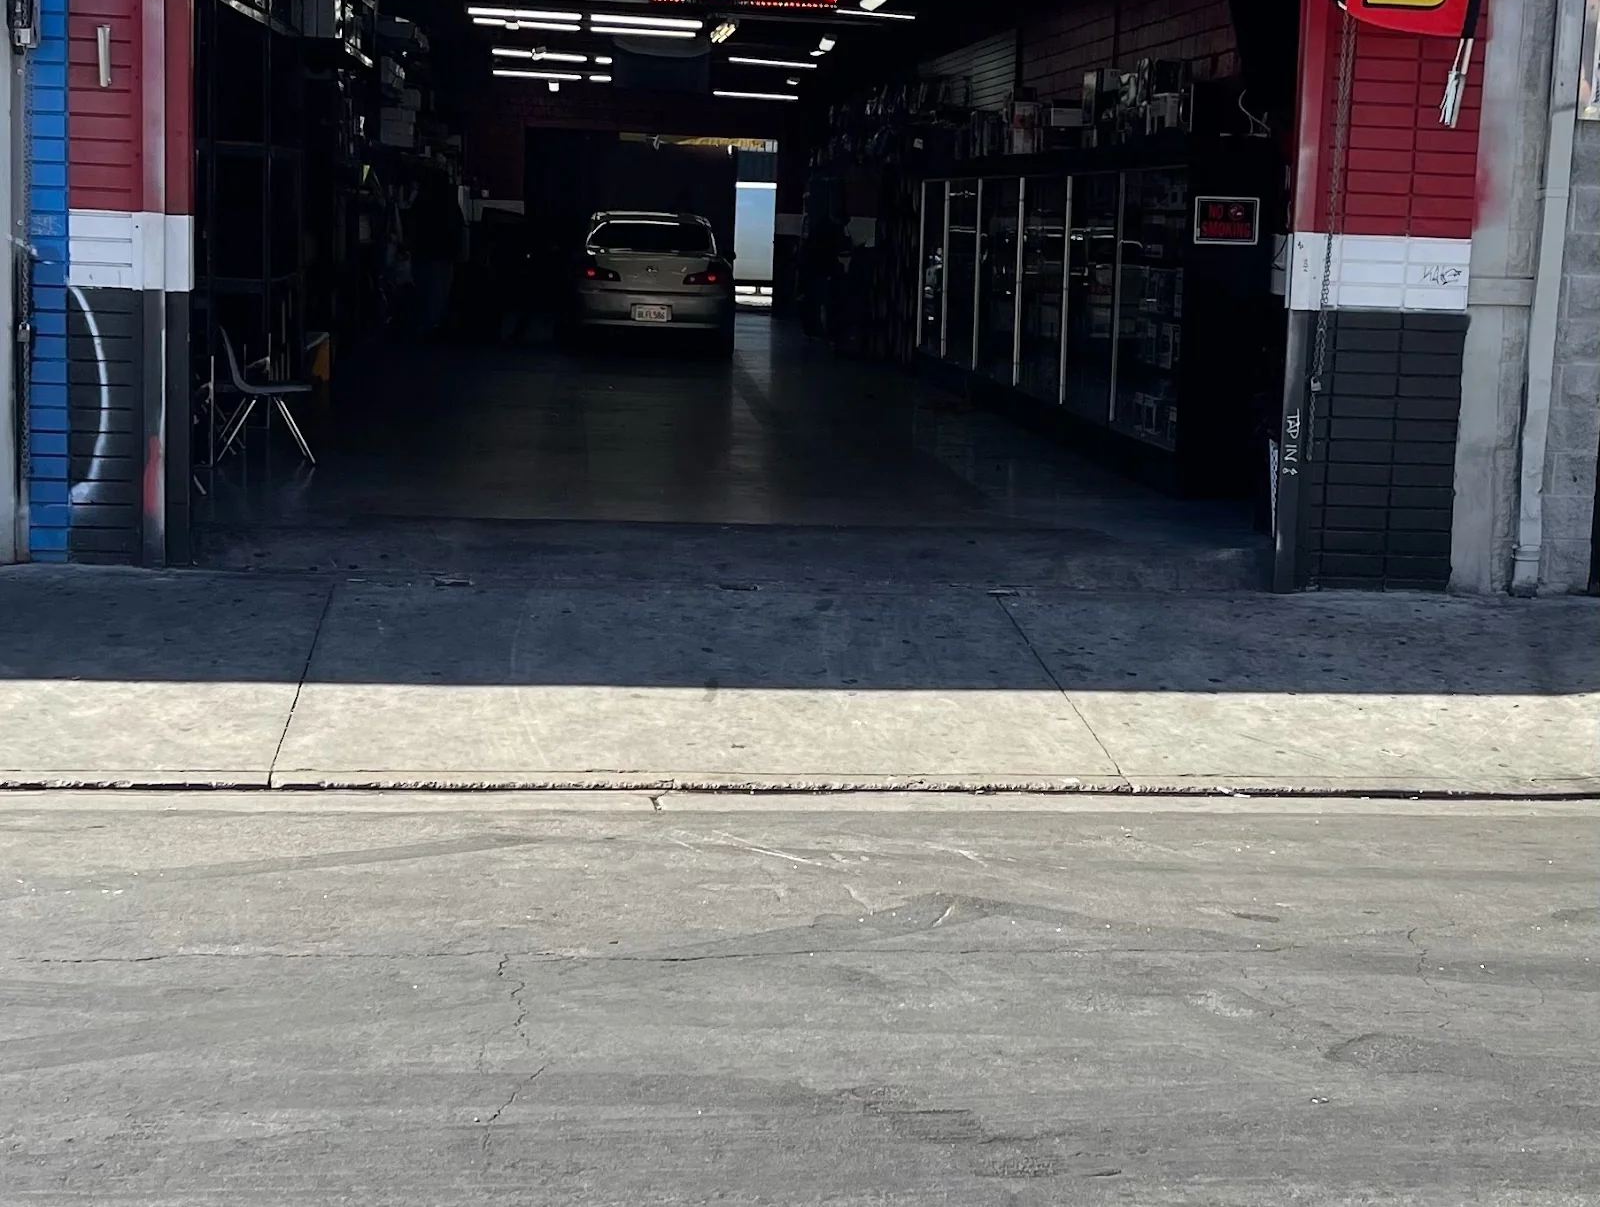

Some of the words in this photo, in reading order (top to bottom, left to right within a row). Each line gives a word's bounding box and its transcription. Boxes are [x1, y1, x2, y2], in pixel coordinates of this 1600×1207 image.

[1208, 203, 1224, 219] NO
[1202, 221, 1251, 238] SMOKING
[1286, 408, 1301, 439] TAP
[1284, 444, 1298, 462] IN
